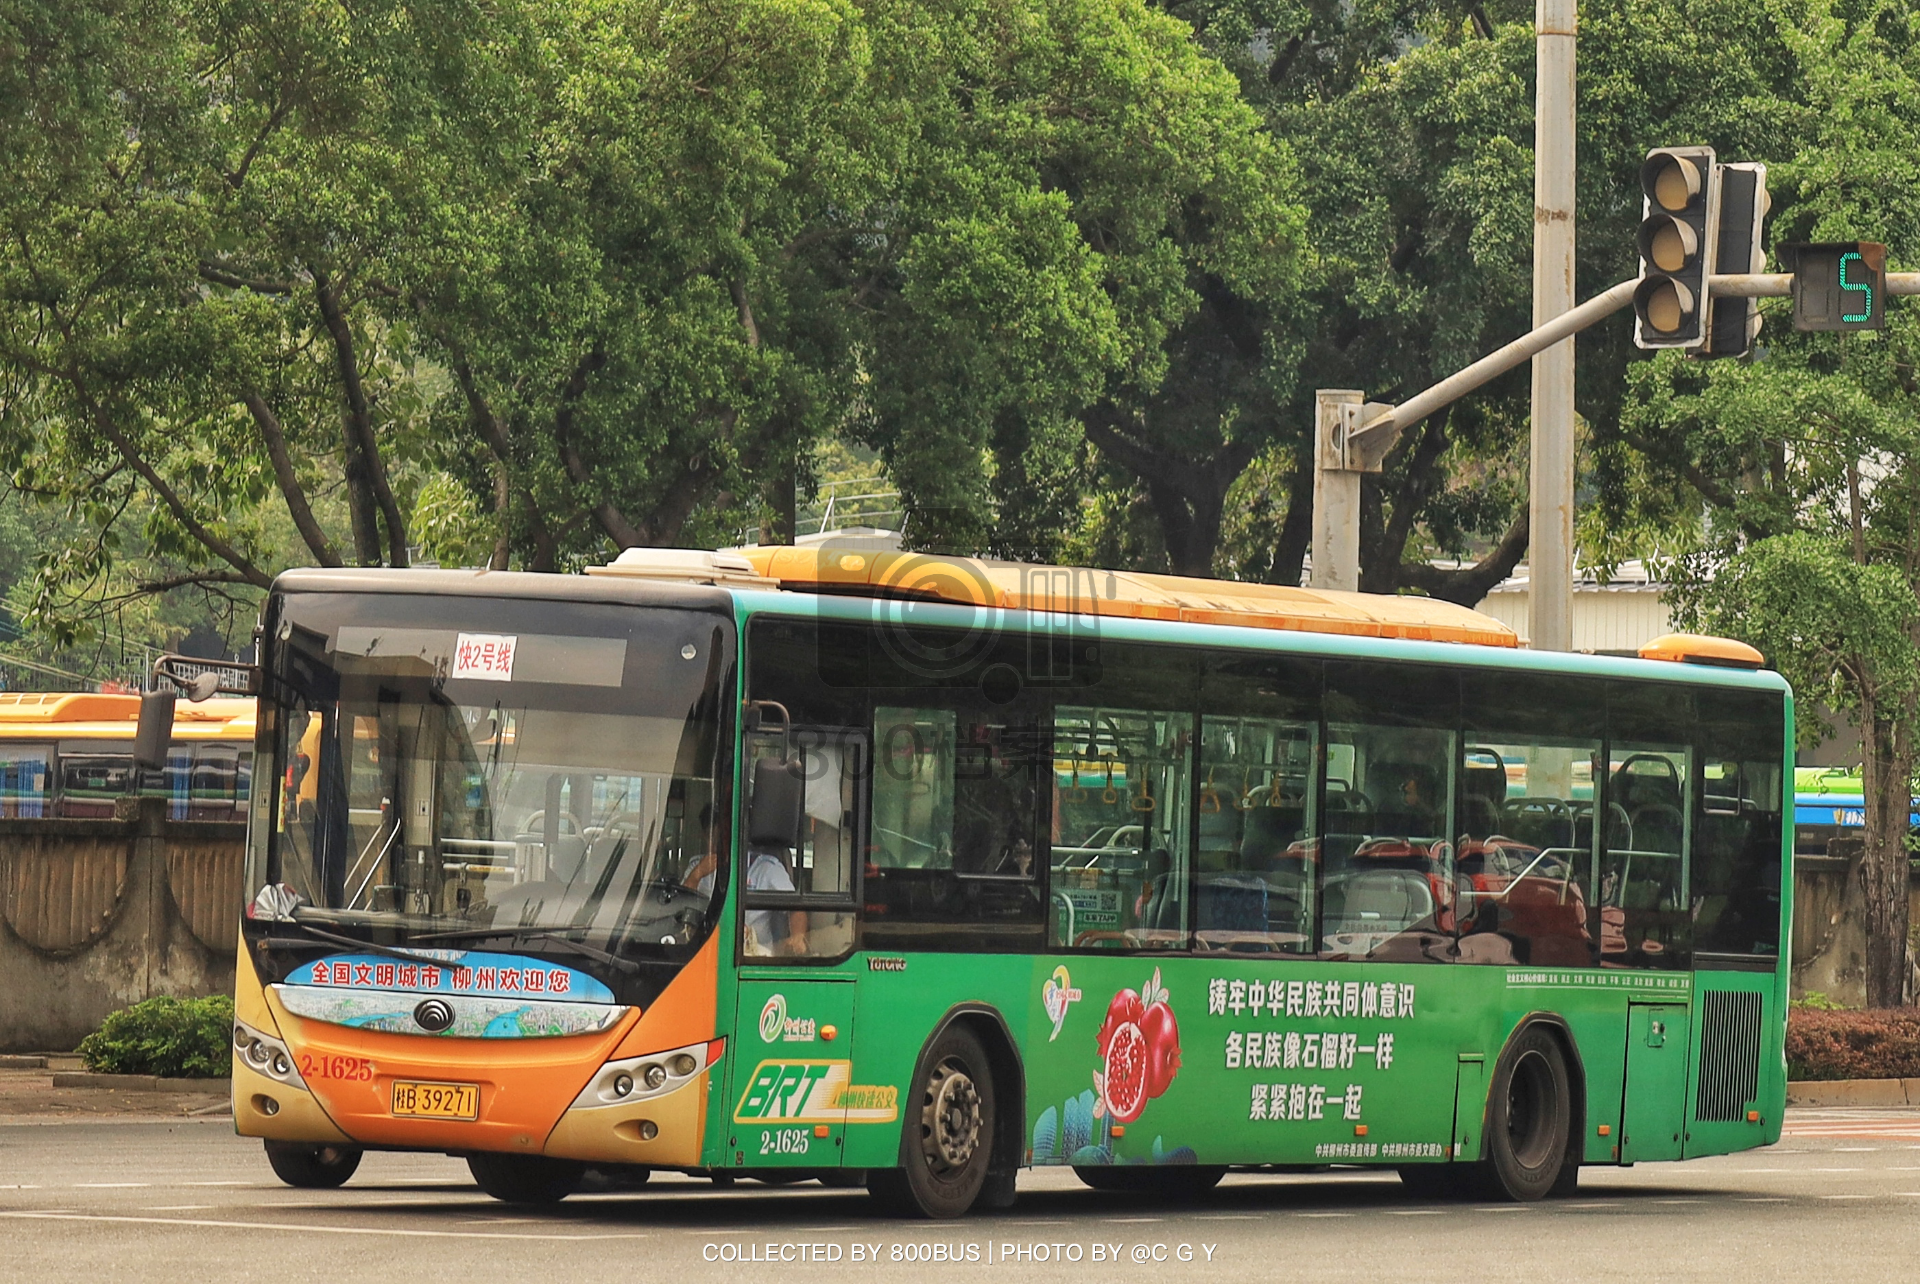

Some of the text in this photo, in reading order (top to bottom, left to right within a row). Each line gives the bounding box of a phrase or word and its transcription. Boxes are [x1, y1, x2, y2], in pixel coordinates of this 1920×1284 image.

[1839, 252, 1872, 323] 5
[458, 641, 511, 674] 快2号线
[312, 961, 571, 994] 全国文明城市 柳州欢迎您
[867, 957, 907, 972] YUTONG
[1208, 978, 1415, 1019] 铸牢中华民族共同体意识
[301, 1054, 374, 1082] 2-1625
[1225, 1031, 1394, 1070] 各民族像石榴籽一样
[737, 1065, 831, 1118] BRT
[1249, 1083, 1363, 1121] 紧紧抱在一起
